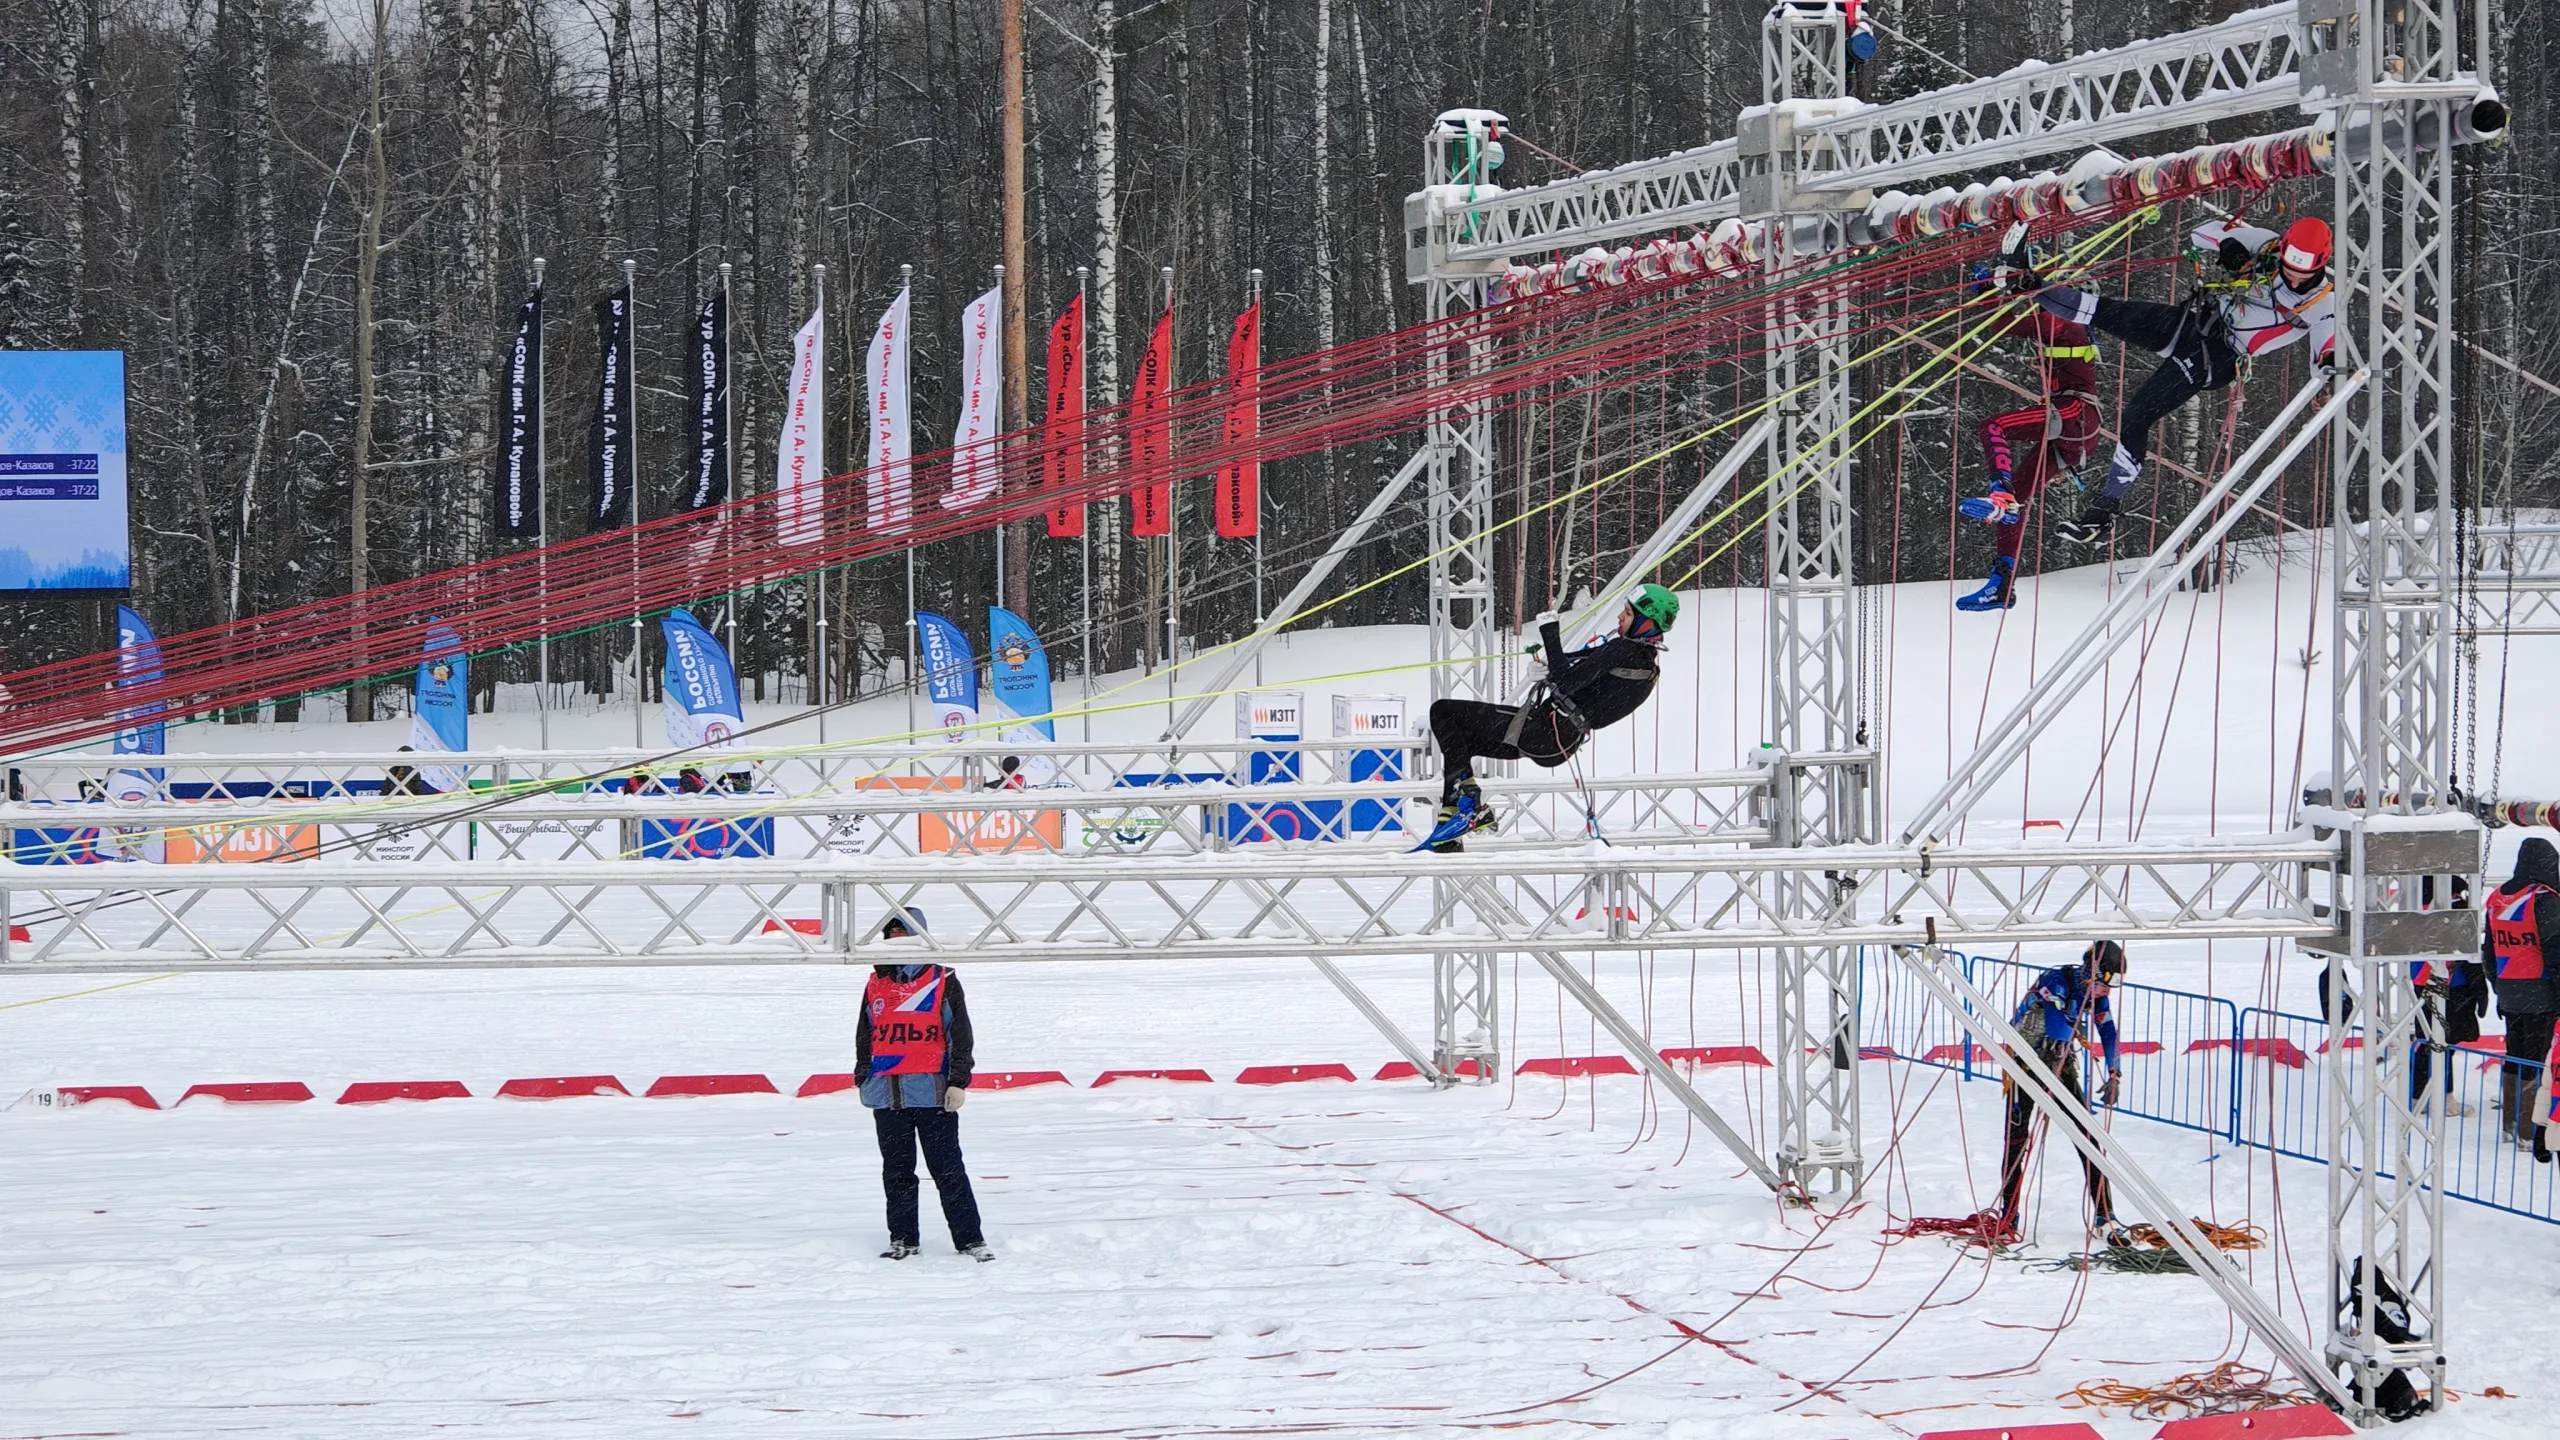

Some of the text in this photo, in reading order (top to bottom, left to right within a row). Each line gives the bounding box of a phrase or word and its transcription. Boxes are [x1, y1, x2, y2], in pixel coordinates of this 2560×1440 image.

[2291, 255, 2303, 265] 12
[701, 321, 713, 339] УР
[976, 322, 987, 339] УР
[511, 337, 526, 384] «СОЛК
[702, 343, 716, 389] «СОЛК
[512, 387, 524, 411] им.
[604, 387, 615, 411] им.
[703, 392, 714, 415] им.
[878, 391, 890, 414] им.
[971, 389, 981, 412] им.
[794, 399, 806, 420] им.
[513, 414, 526, 424] Г.
[603, 414, 616, 424] Г.
[702, 418, 714, 428] Г.
[879, 417, 891, 427] Г.
[970, 415, 980, 424] Г.
[512, 427, 525, 442] А.
[604, 426, 616, 441] А.
[794, 424, 806, 434] Г.
[703, 431, 715, 445] А.
[880, 430, 892, 444] А.
[794, 437, 806, 452] А.
[0, 460, 55, 471] ов-Казаков
[0, 485, 56, 497] ов-Казаков
[508, 445, 525, 527] Кулаковой»
[1269, 709, 1296, 722] ИЗТТ
[1371, 715, 1399, 729] ИЗТТ
[376, 845, 415, 853] МИНСПОРТ
[37, 1093, 52, 1107] 19
